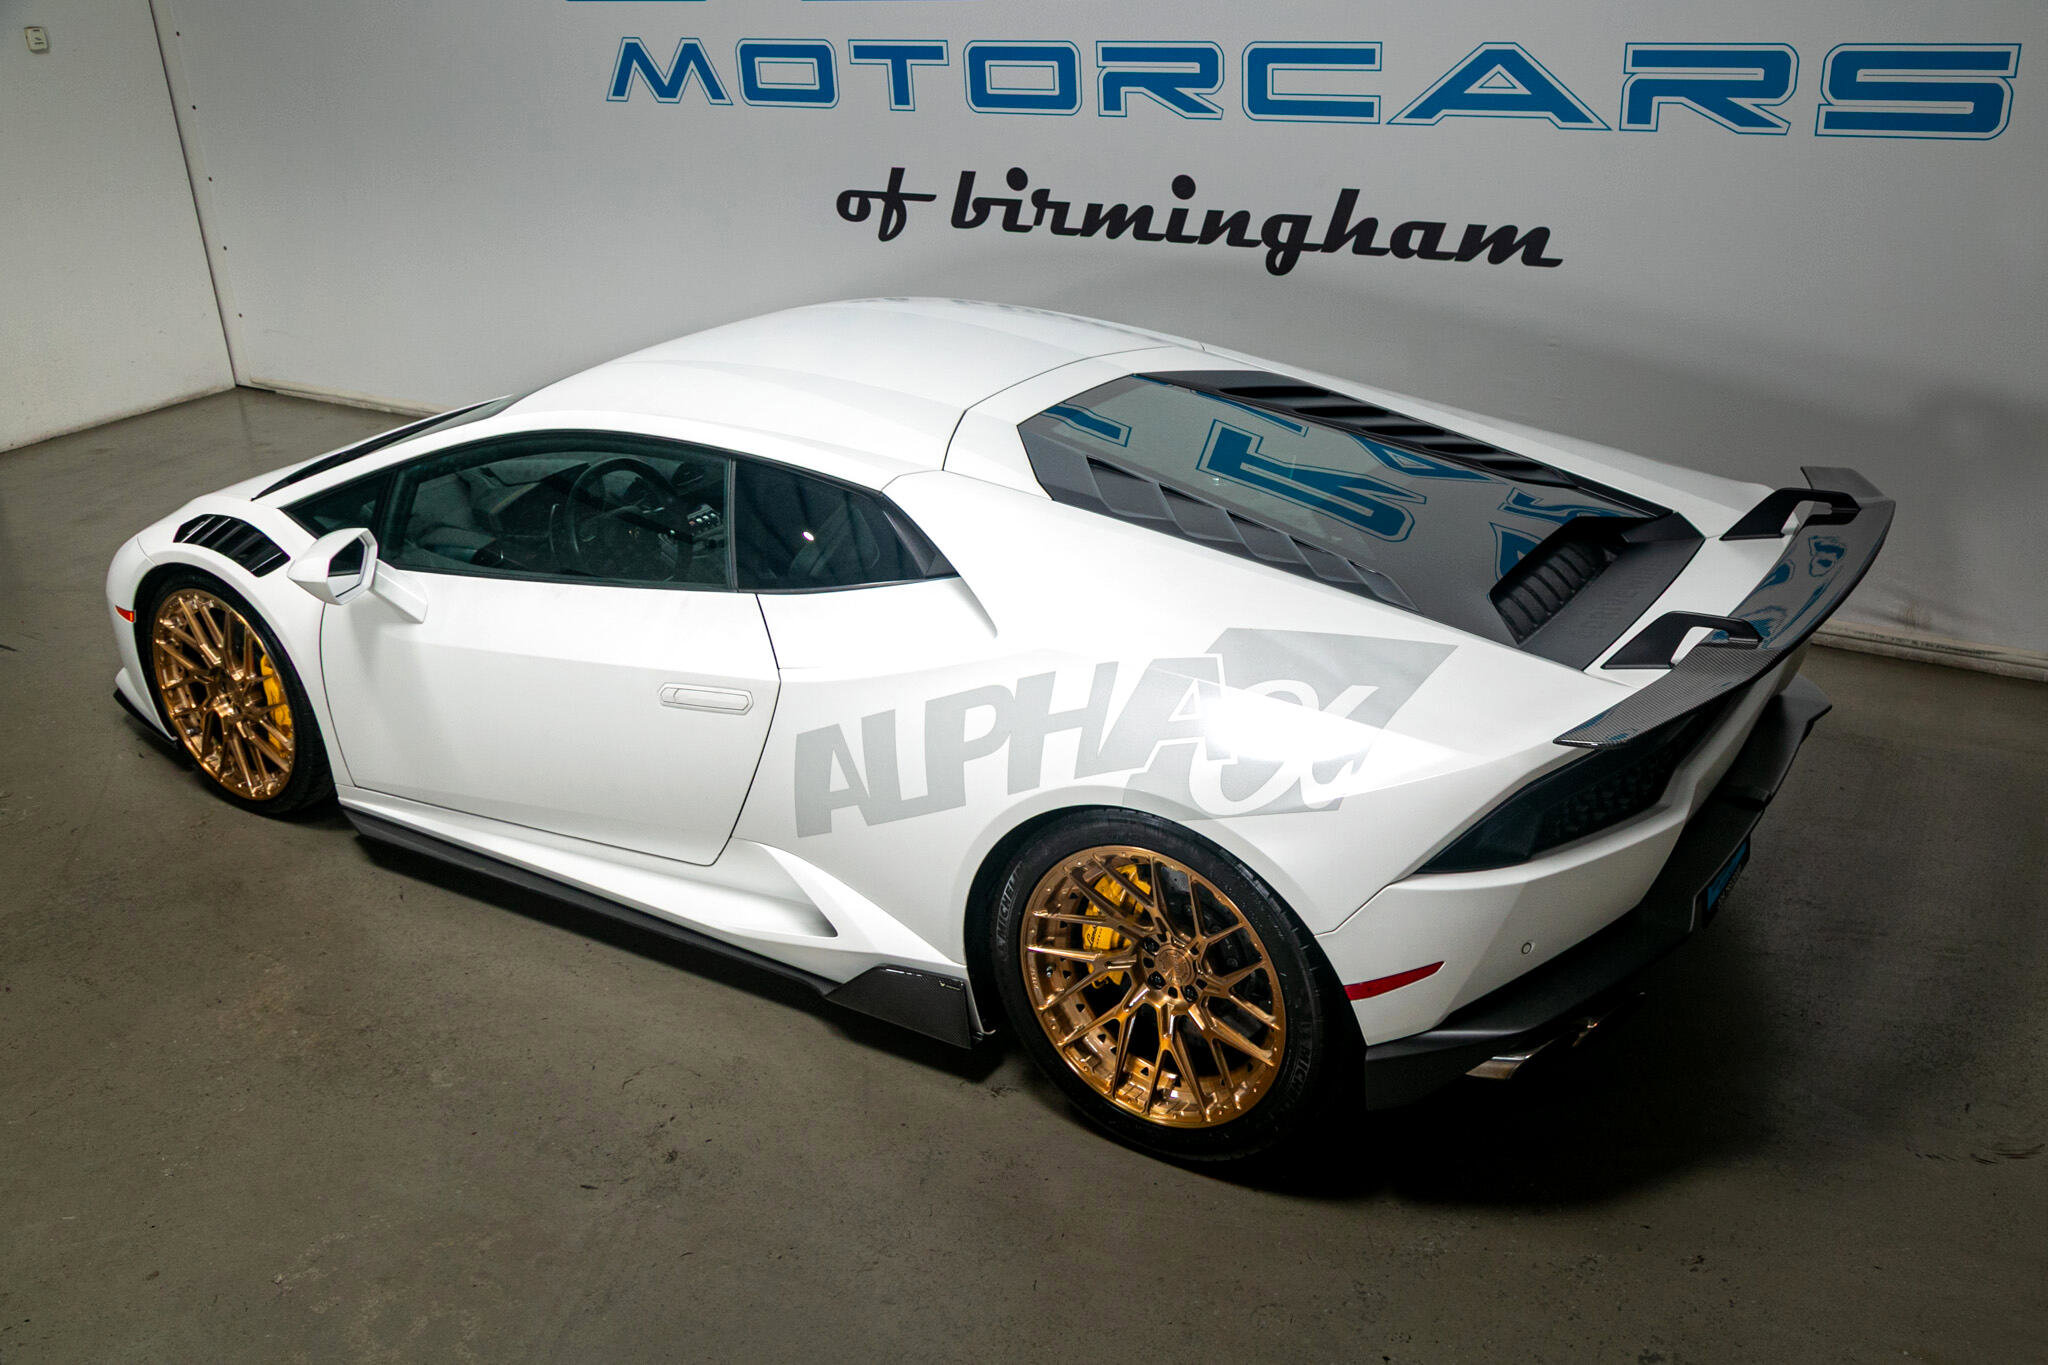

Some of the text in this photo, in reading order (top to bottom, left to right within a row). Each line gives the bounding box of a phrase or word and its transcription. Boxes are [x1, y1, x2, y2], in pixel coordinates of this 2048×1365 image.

[606, 37, 2022, 140] MOTORCARS
[836, 167, 1563, 276] of birmingham
[795, 656, 1233, 838] ALPHA
